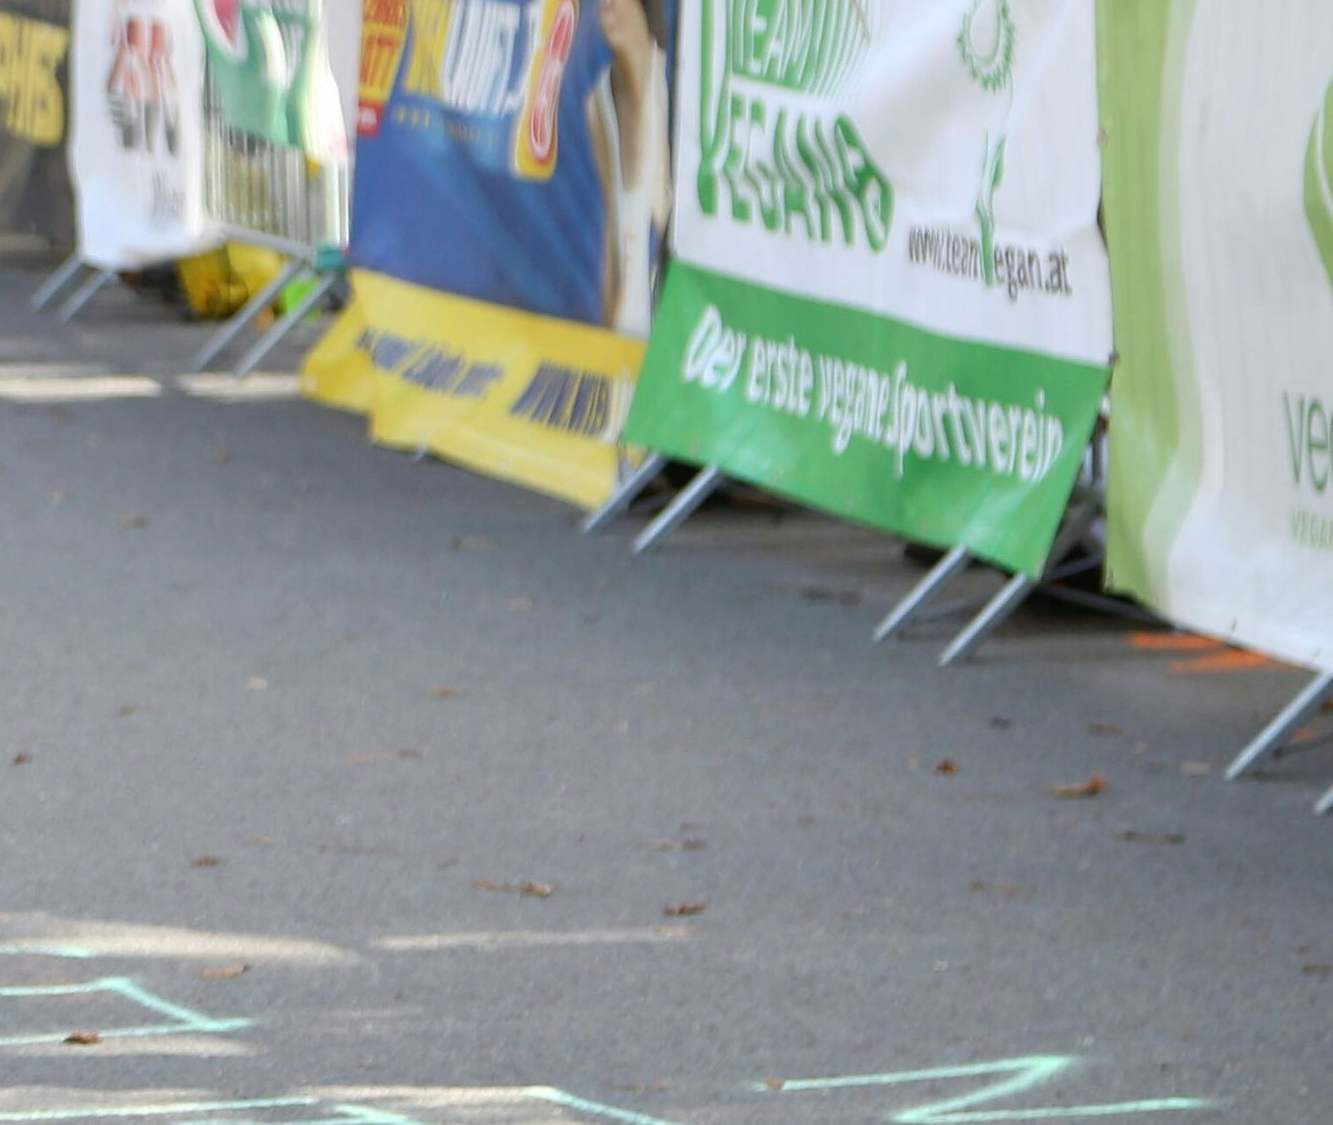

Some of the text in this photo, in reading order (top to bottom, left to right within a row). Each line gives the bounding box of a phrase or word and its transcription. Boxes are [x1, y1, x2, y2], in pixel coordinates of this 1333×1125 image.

[682, 304, 746, 393] Der
[746, 335, 815, 419] erste
[816, 352, 890, 455] vegane
